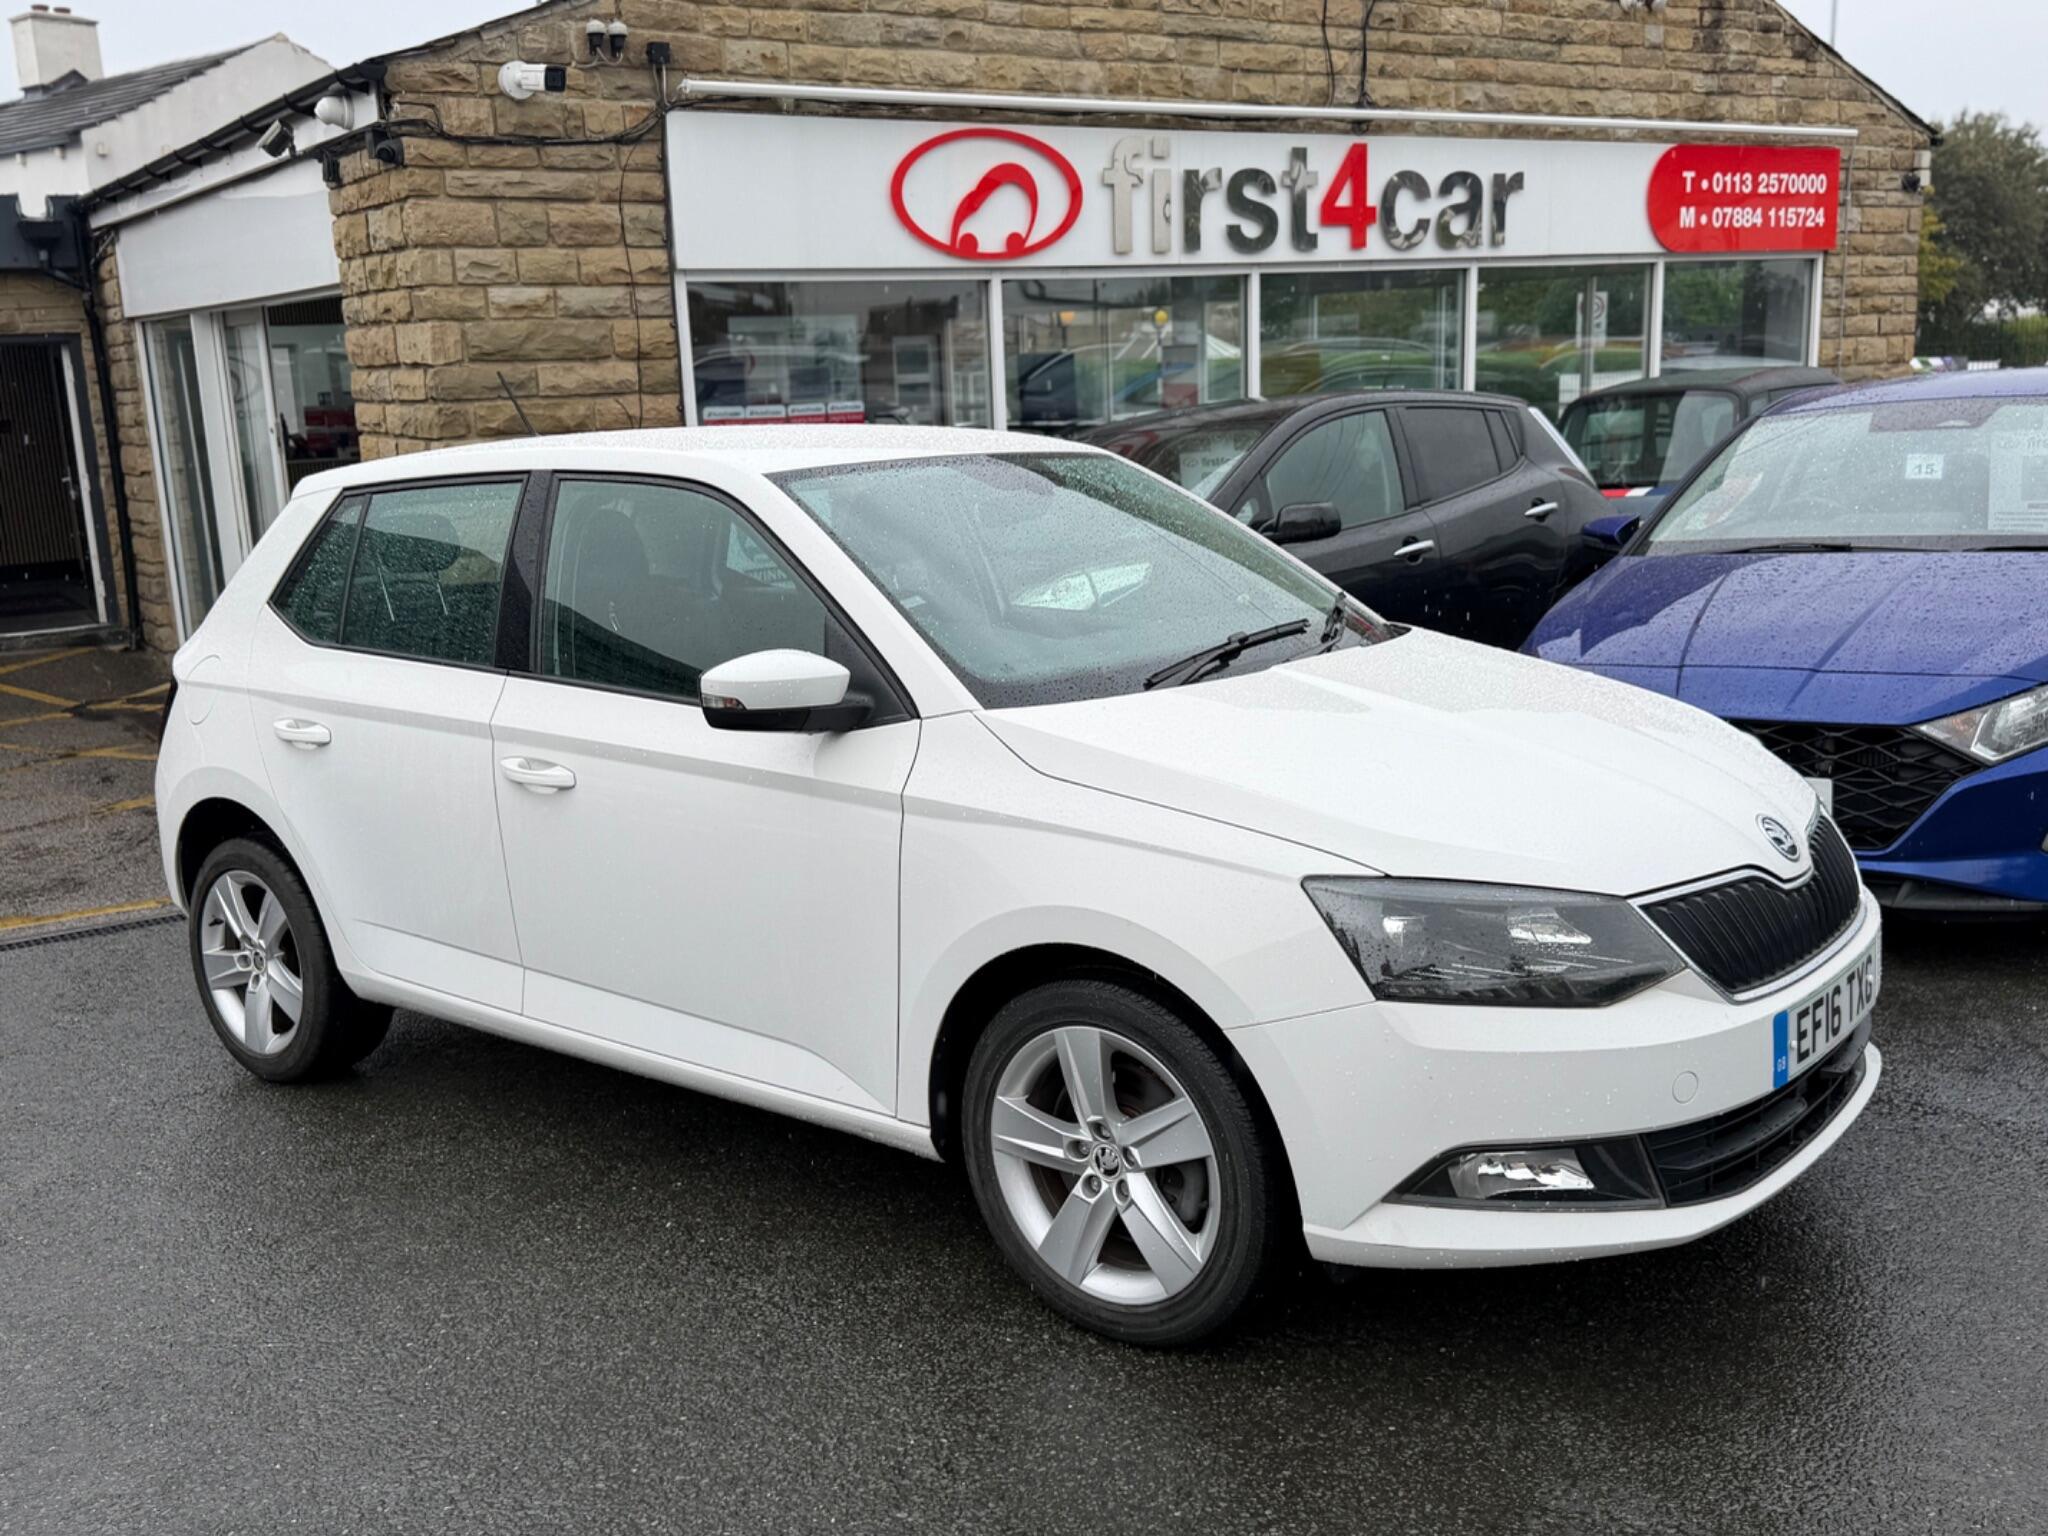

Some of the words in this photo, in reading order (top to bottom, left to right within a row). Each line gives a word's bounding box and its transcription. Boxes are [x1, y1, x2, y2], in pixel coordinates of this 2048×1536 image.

[1103, 136, 1525, 255] first4car
[1682, 170, 1696, 193] T
[1712, 171, 1752, 194] 0113
[1757, 172, 1828, 195] 2570000
[1680, 205, 1696, 229] M
[1712, 206, 1763, 229] 07884
[1768, 206, 1825, 228] 115724
[1796, 984, 1842, 1065] EF16
